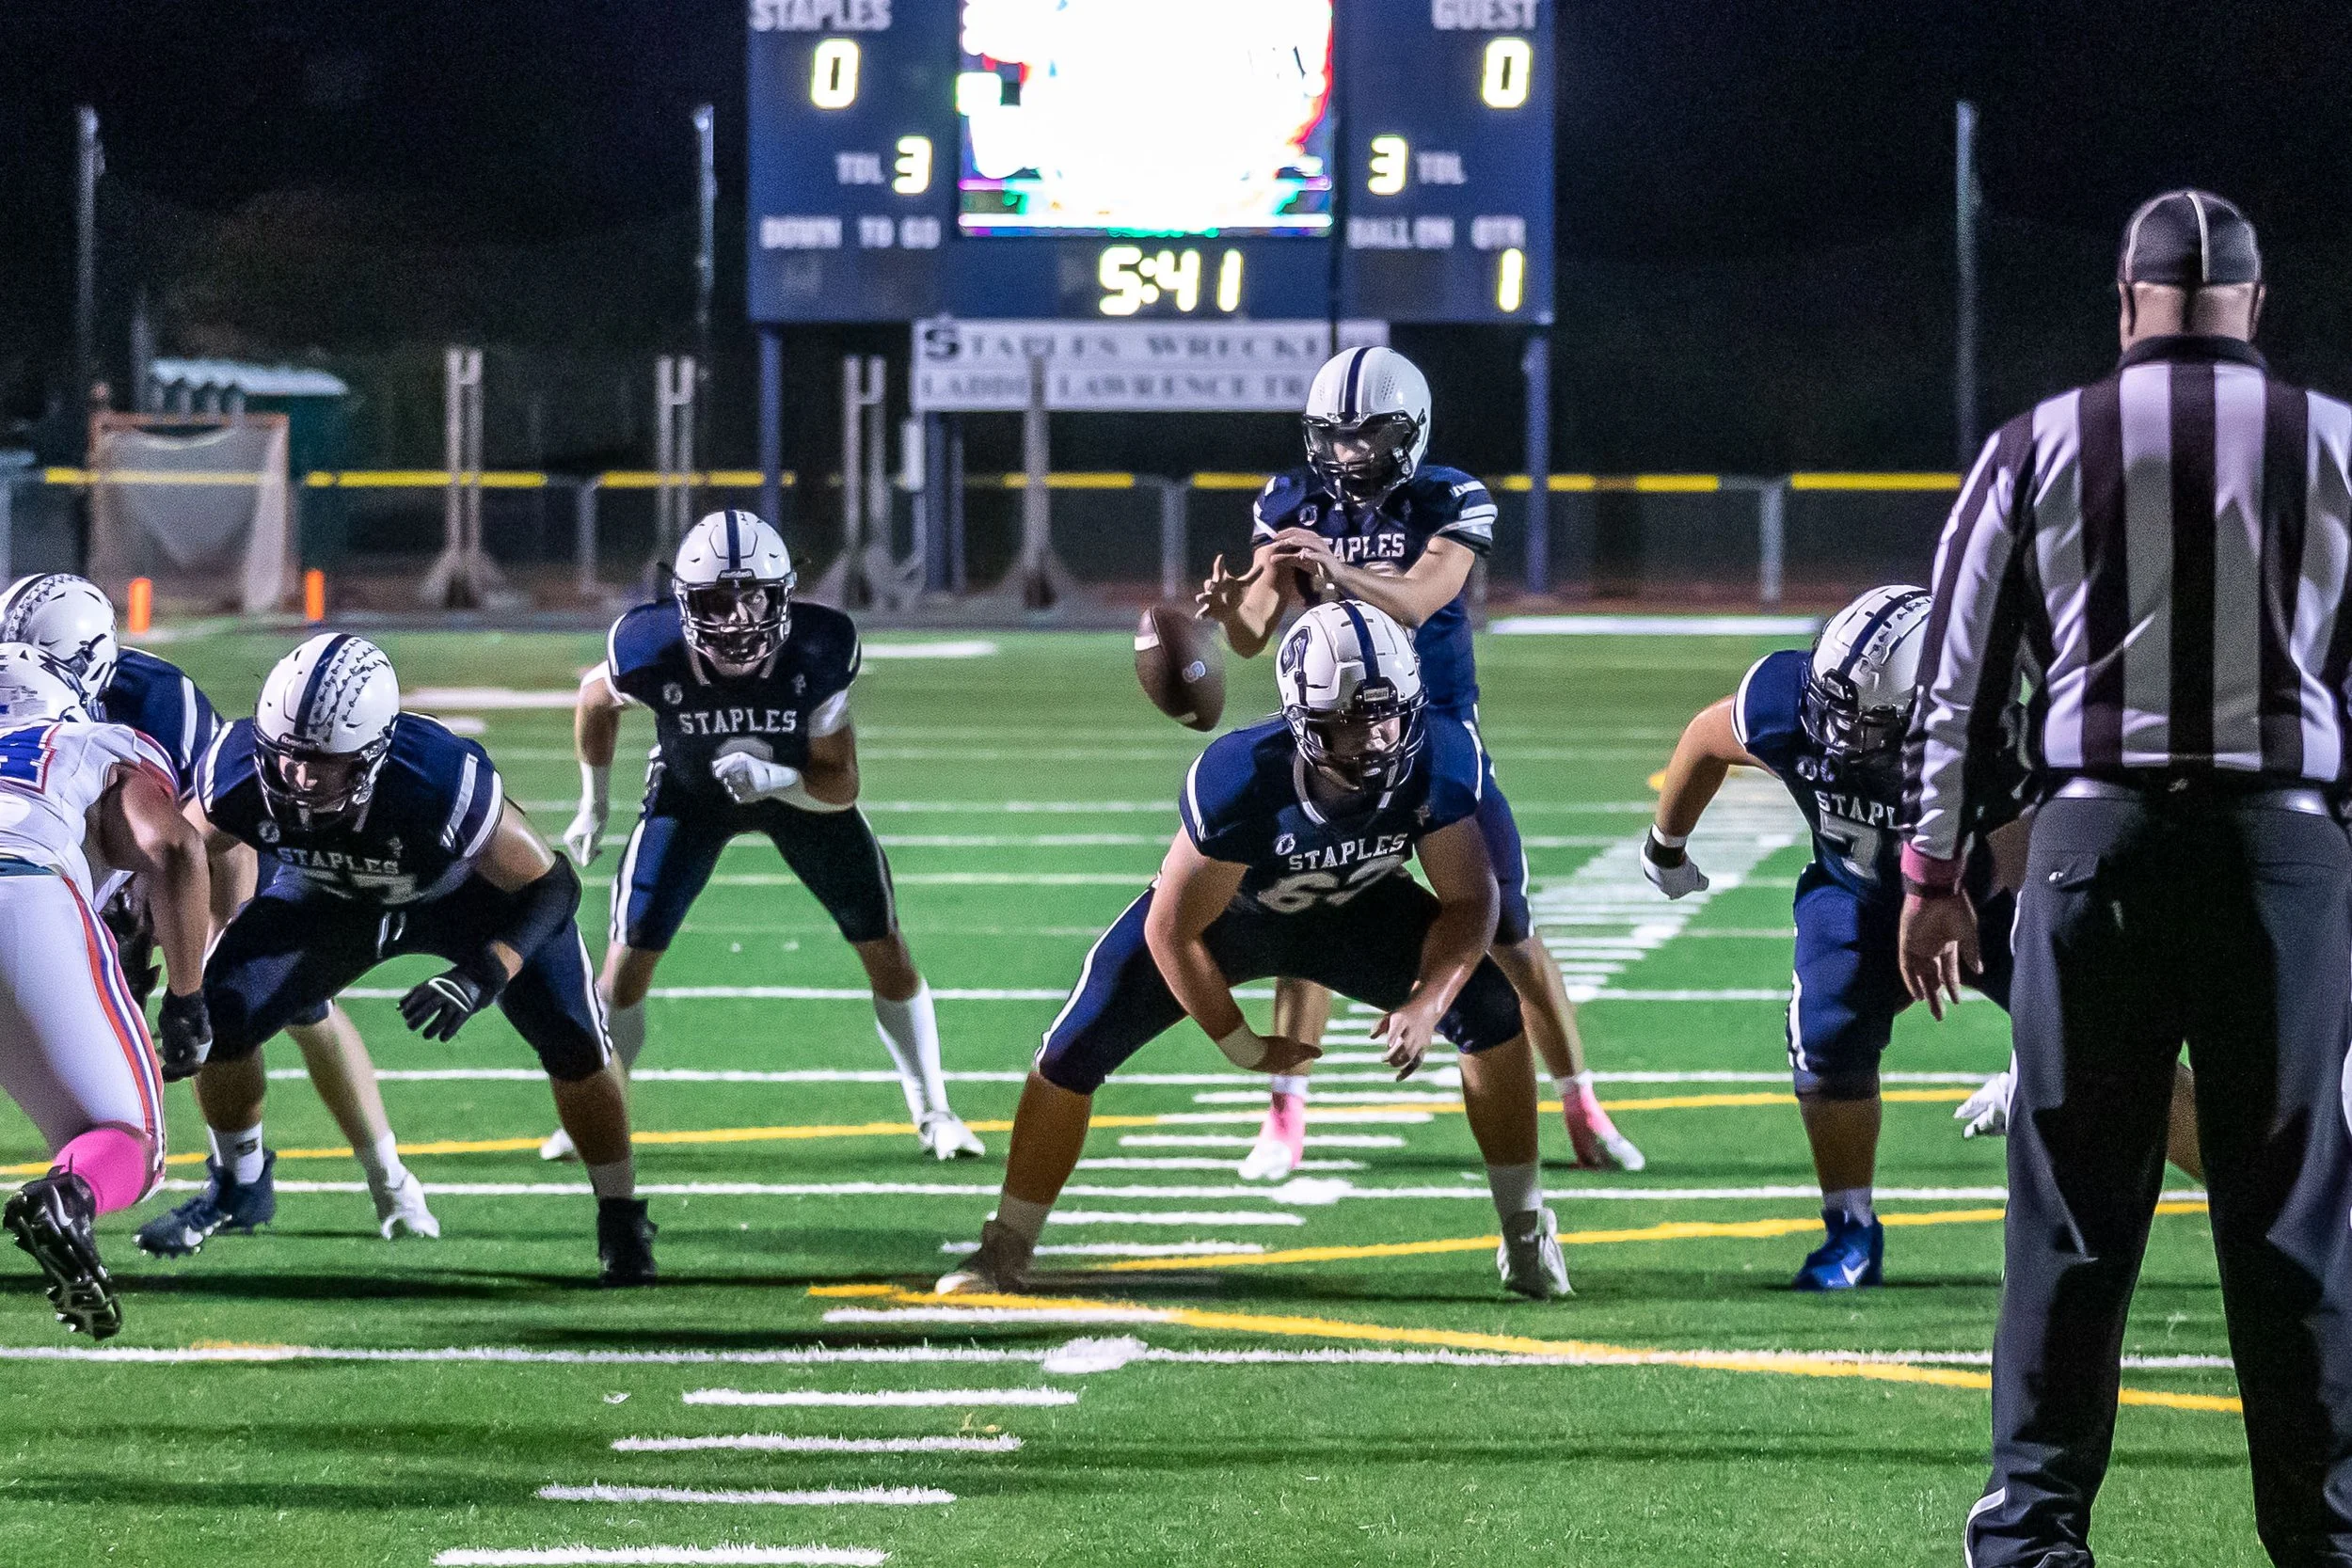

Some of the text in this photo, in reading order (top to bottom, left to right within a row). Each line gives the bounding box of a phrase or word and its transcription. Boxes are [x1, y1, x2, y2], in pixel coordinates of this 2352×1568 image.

[751, 0, 892, 31] STAPLES
[1432, 0, 1537, 30] GUEST
[810, 39, 860, 109] 0
[1482, 38, 1532, 108] 0
[892, 135, 932, 195] 3
[1367, 135, 1407, 195] 3
[760, 216, 842, 249] DOWN
[859, 216, 895, 249] TO
[1098, 245, 1244, 316] 5:41
[1498, 246, 1525, 312] 1
[1145, 335, 1319, 359] WRECKE
[1322, 533, 1406, 562] APLES
[678, 708, 798, 735] STAPLES
[1814, 789, 1899, 830] STAPL
[277, 847, 400, 876] STAPLES
[1289, 832, 1408, 871] STAPLES
